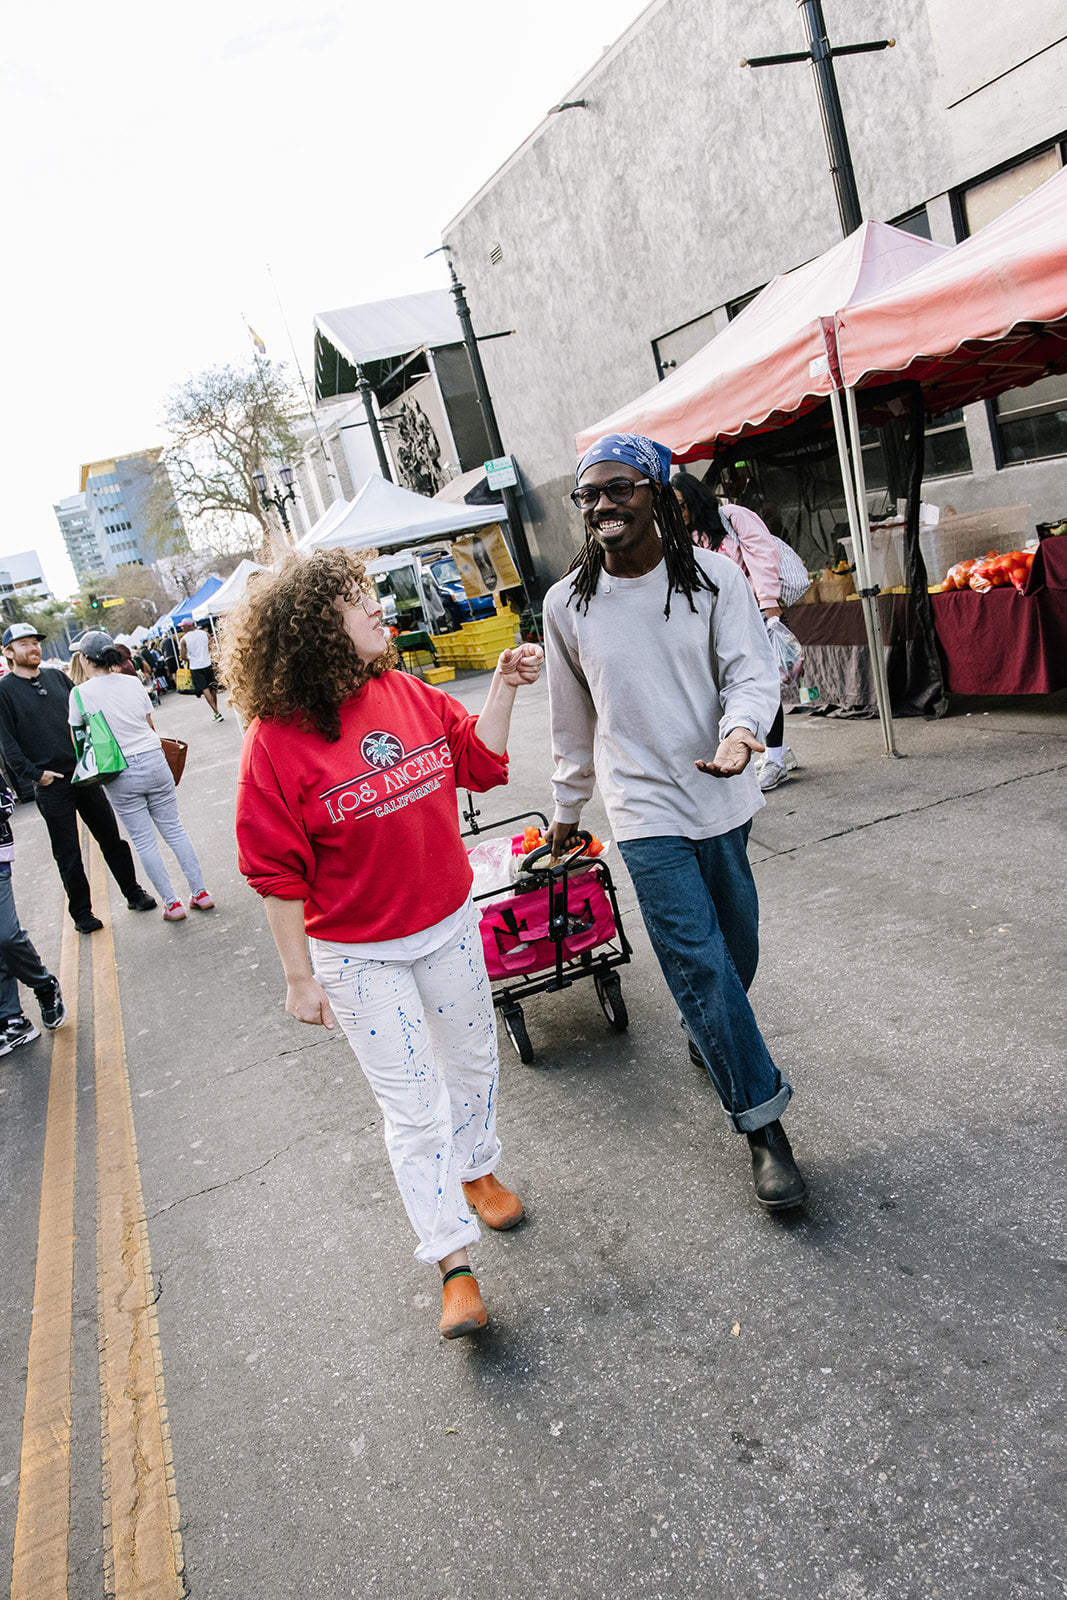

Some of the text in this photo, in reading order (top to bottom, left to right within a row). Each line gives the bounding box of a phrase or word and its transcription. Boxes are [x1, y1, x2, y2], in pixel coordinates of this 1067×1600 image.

[487, 461, 494, 470] 2
[325, 743, 454, 824] LOS ANGELES
[375, 778, 441, 817] CALIFORNIA
